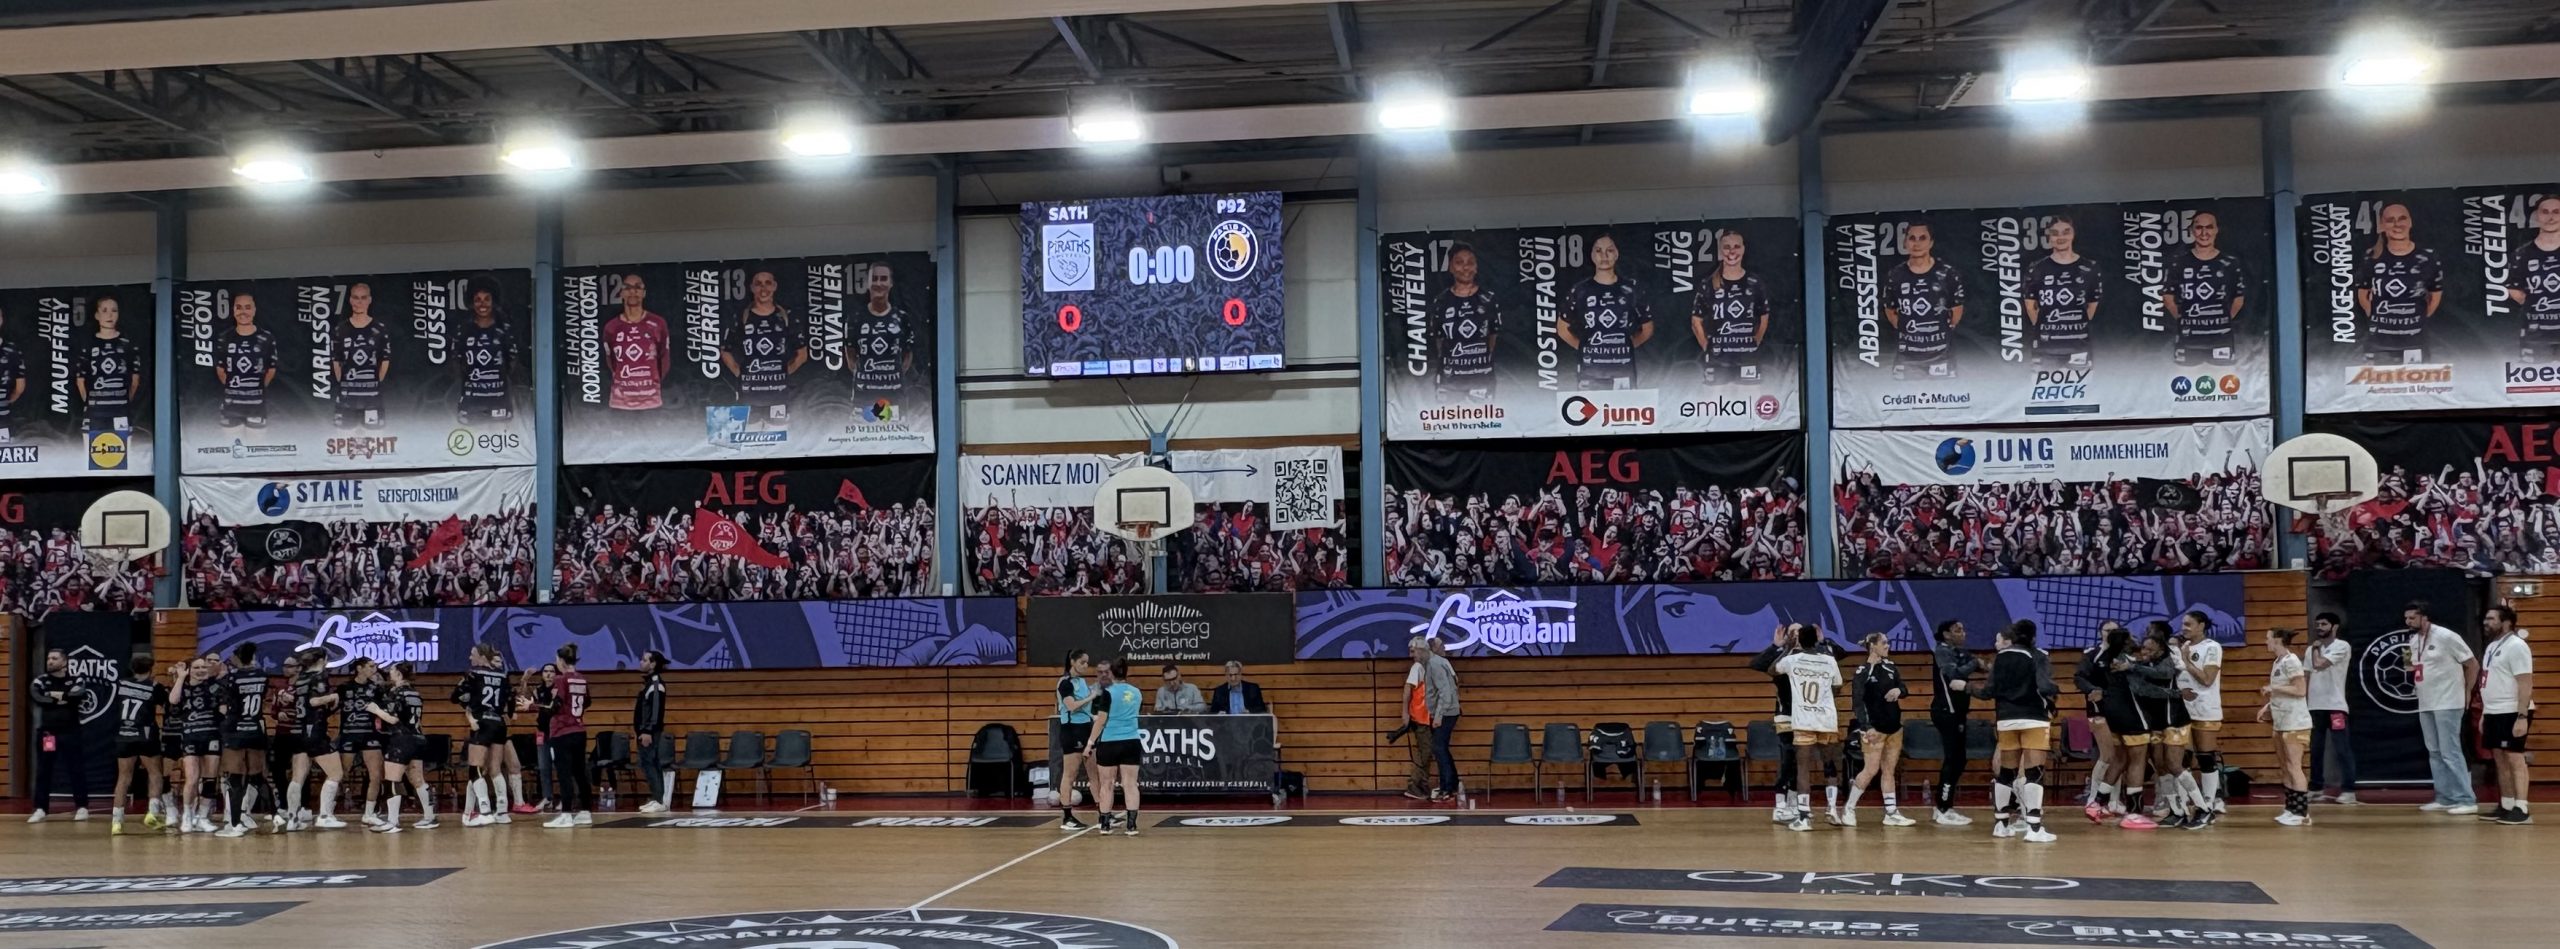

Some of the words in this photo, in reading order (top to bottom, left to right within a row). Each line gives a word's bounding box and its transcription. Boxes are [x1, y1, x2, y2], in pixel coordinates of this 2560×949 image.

[1048, 205, 1088, 221] SATH
[1217, 199, 1246, 214] P92
[2023, 216, 2054, 251] 33
[2164, 210, 2197, 245] 35
[2311, 203, 2330, 264] OLIVIA
[2463, 196, 2483, 255] EMMA
[1048, 239, 1091, 256] PIRATHS
[1428, 239, 1454, 273] 17
[1519, 236, 1535, 283] YOSR
[1557, 234, 1584, 268] 18
[1655, 231, 1671, 269] LISA
[1836, 224, 1855, 290] DALILA
[1981, 218, 1998, 272] NORA
[2124, 211, 2142, 284] ALBANE
[2482, 195, 2510, 316] TUCCELLA
[1129, 245, 1195, 285] 0:00
[1389, 241, 1406, 315] MÉLISSA
[1671, 231, 1693, 293] VLUG
[2140, 212, 2165, 331] FRACHON
[2328, 203, 2356, 343] ROUGE-CARRASSAT
[600, 273, 624, 306] 12
[722, 268, 746, 301] 13
[844, 263, 868, 295] 15
[1854, 224, 1880, 367] ABDESSELAM
[1998, 216, 2024, 362] SNEDKERUD
[72, 297, 86, 327] 5
[181, 291, 195, 339] LILOU
[216, 288, 230, 320] 6
[298, 286, 312, 323] ELIN
[334, 284, 347, 315] 7
[413, 281, 428, 339] LOUISE
[808, 264, 824, 361] CORENTINE
[1223, 298, 1247, 326] 0
[1404, 241, 1428, 376] CHANTELLY
[1534, 236, 1558, 390] MOSTEFAOUI
[38, 297, 52, 341] JULIA
[194, 290, 214, 367] BEGON
[427, 280, 447, 365] CUSSET
[563, 276, 581, 376] ELIHANNAH
[683, 270, 701, 363] CHARLÈNE
[700, 269, 721, 379] GUERRIER
[823, 263, 843, 371] CAVALIER
[1058, 304, 1082, 333] 0
[50, 297, 70, 414] MAUFFREY
[311, 286, 331, 399] KARLSSON
[2036, 368, 2091, 385] POLY
[2346, 365, 2453, 386] Antoni
[2505, 362, 2560, 383] koe
[1680, 396, 1747, 418] emka
[2031, 384, 2087, 400] RACK
[1420, 404, 1505, 421] cuisinella
[1602, 403, 1655, 427] jung
[0, 447, 38, 463] ARK
[326, 436, 398, 458] SPECHT
[478, 429, 520, 453] egis
[1983, 437, 2054, 462] JUNG
[2071, 442, 2169, 461] MOMMENHEIM
[2483, 424, 2560, 463] AE
[981, 463, 1062, 487] SCANNEZ
[1066, 462, 1100, 485] MOI
[1546, 449, 1640, 485] AEG
[296, 480, 363, 503] STANE
[378, 487, 459, 503] GEISPOLSHEIM
[704, 470, 787, 506] AEG
[1102, 619, 1210, 639] Kochersberg
[1119, 636, 1199, 652] Ackerland
[68, 658, 119, 682] RATHS
[121, 698, 143, 720] 17
[241, 695, 262, 717] 10
[481, 686, 500, 708] 21
[1800, 681, 1820, 705] 10
[1138, 728, 1216, 761] RATHS
[1142, 756, 1203, 768] NDBALL
[1687, 870, 2081, 891] OKKO
[655, 927, 842, 945] PIRATHS
[854, 927, 1042, 948] HANDBALL
[1656, 914, 1920, 932] Butagaz
[2072, 925, 2375, 943] Butagaz
